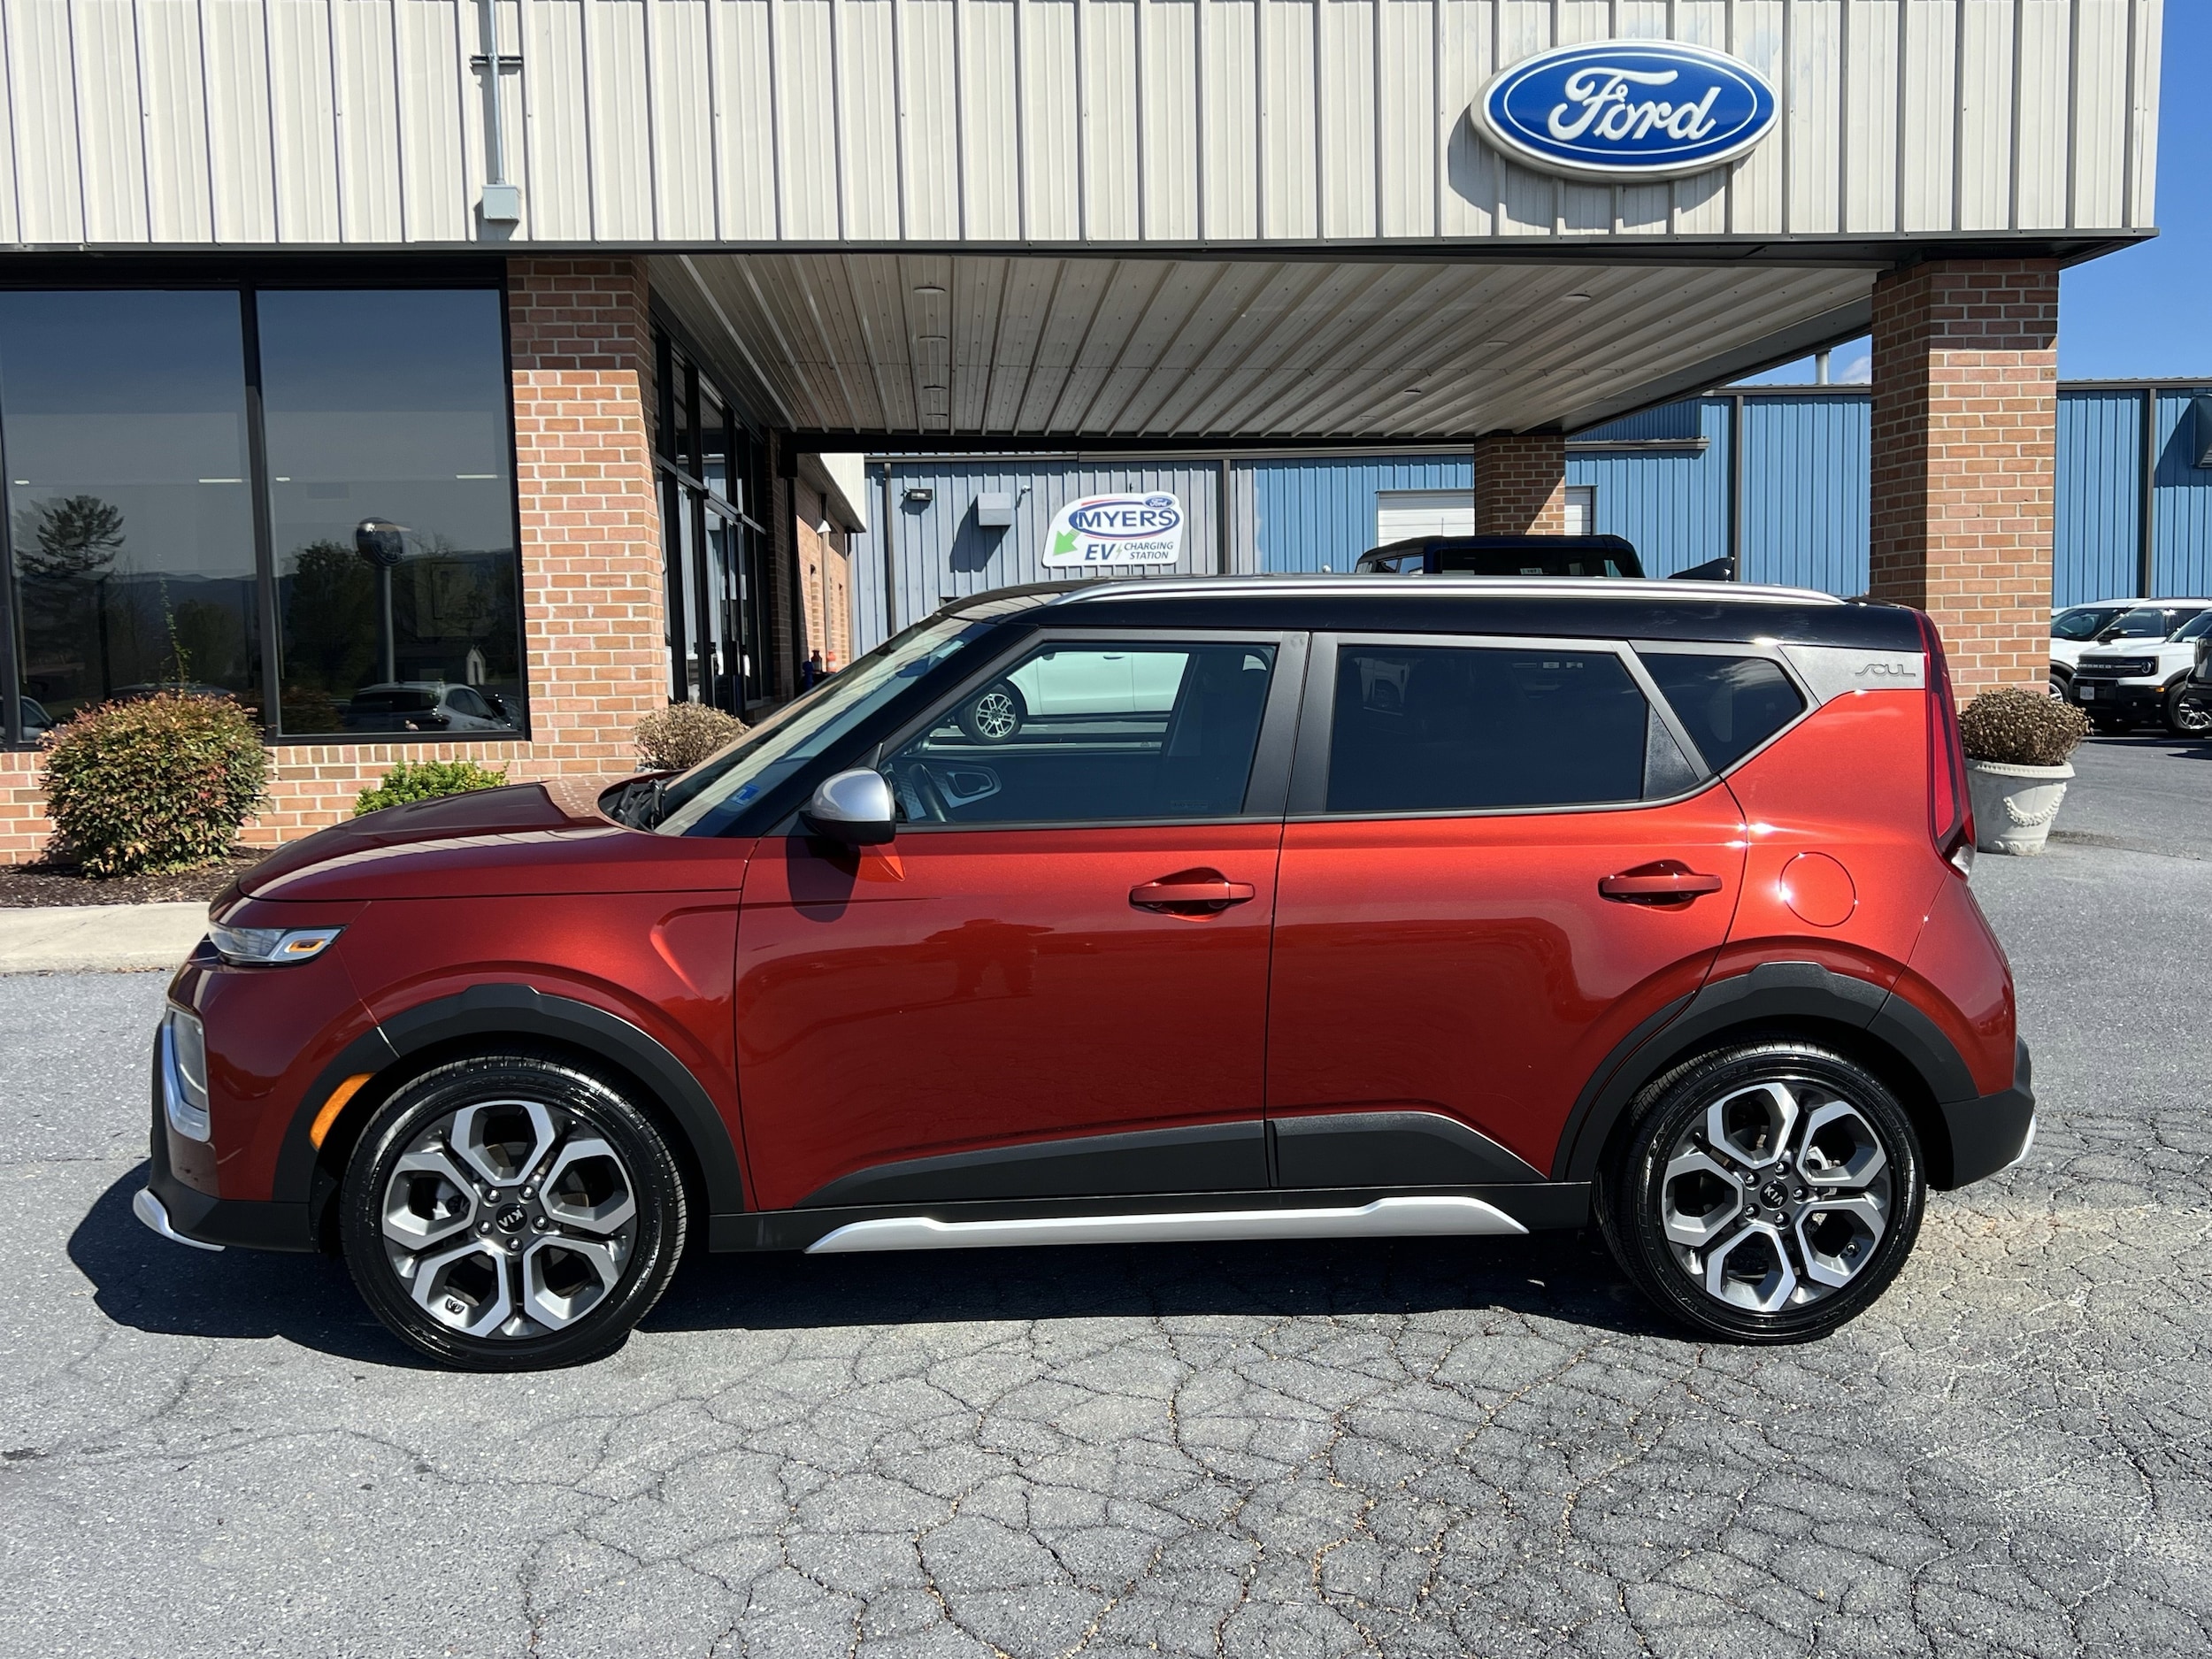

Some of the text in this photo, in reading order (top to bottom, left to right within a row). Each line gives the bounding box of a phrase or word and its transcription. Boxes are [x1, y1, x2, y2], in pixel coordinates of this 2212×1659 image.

[1548, 66, 1722, 141] Ford
[1149, 497, 1168, 507] Ford
[1079, 510, 1173, 527] MYERS
[1085, 543, 1116, 560] EV
[1124, 541, 1174, 551] CHARGING
[1763, 1185, 1784, 1206] KIA
[498, 1209, 524, 1227] KIA
